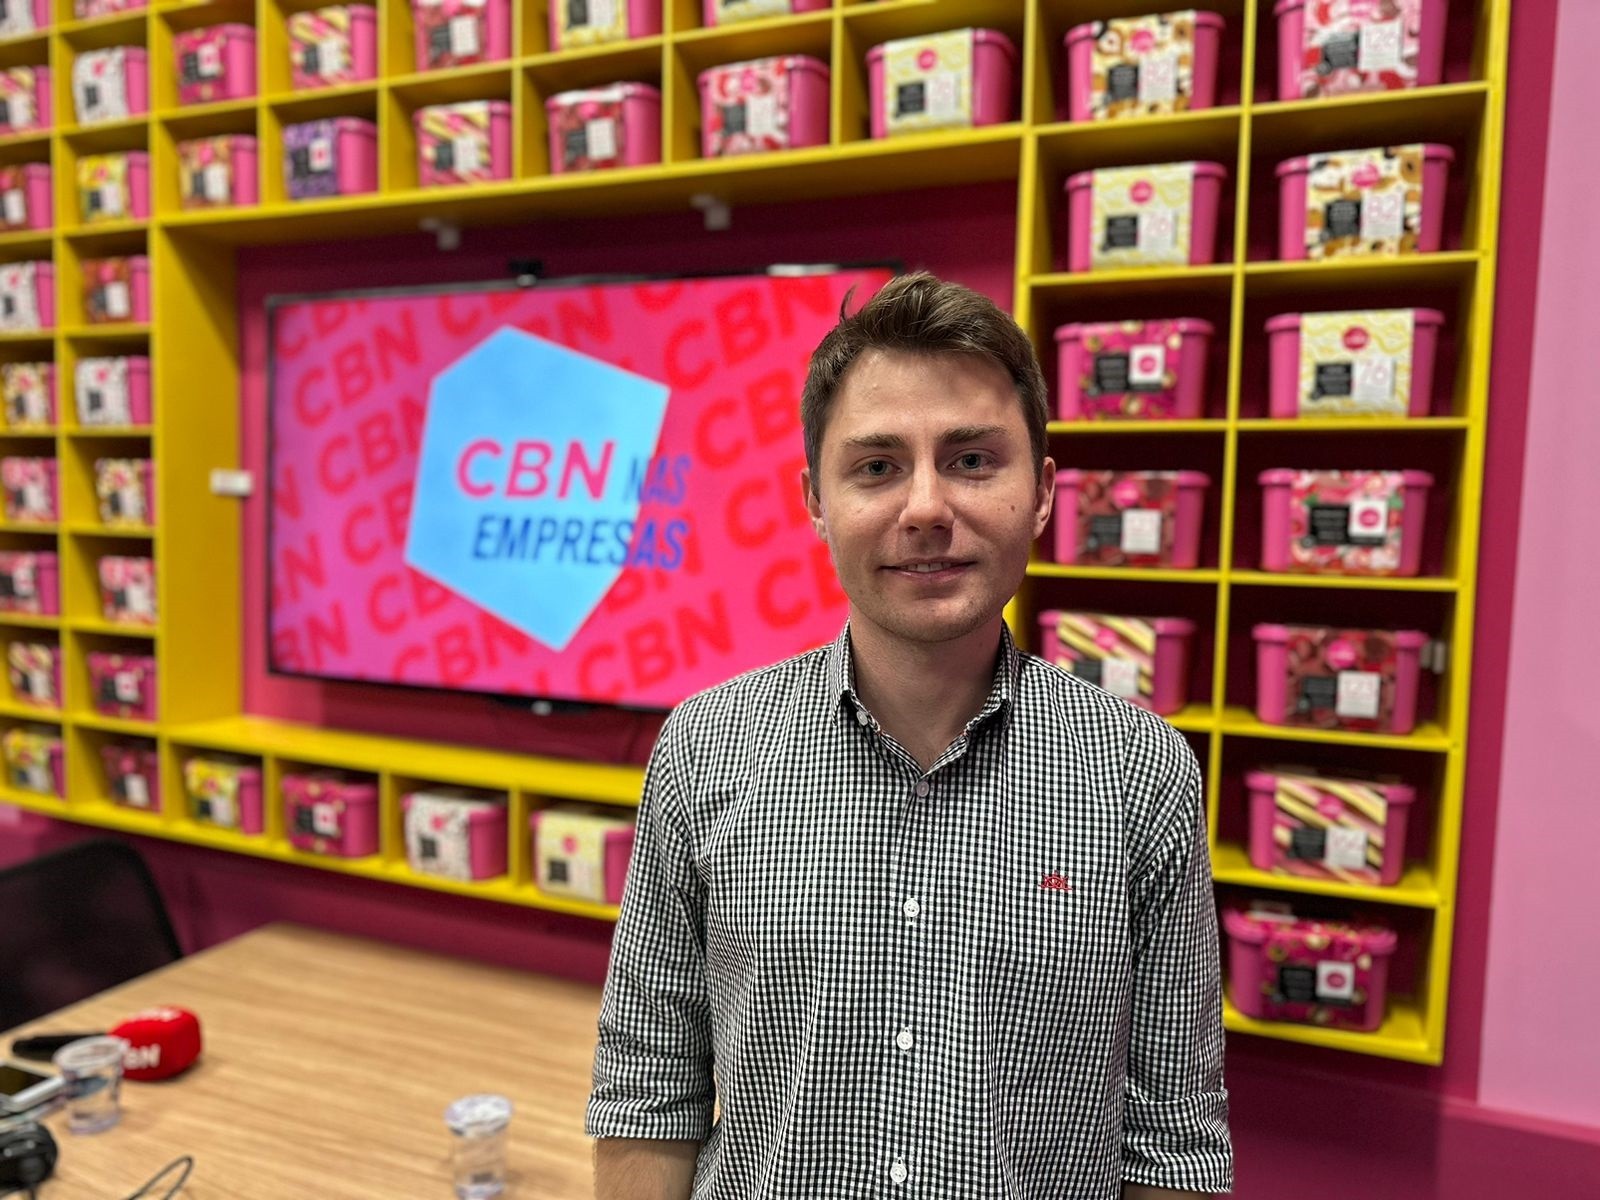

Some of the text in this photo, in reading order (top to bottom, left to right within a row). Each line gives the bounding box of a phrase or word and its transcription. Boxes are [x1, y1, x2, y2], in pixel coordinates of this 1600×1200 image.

[1367, 194, 1398, 219] 82
[293, 304, 422, 430] CBN
[455, 439, 692, 505] CBN NAS
[473, 515, 689, 569] EMPRESAS
[578, 592, 735, 701] CBN
